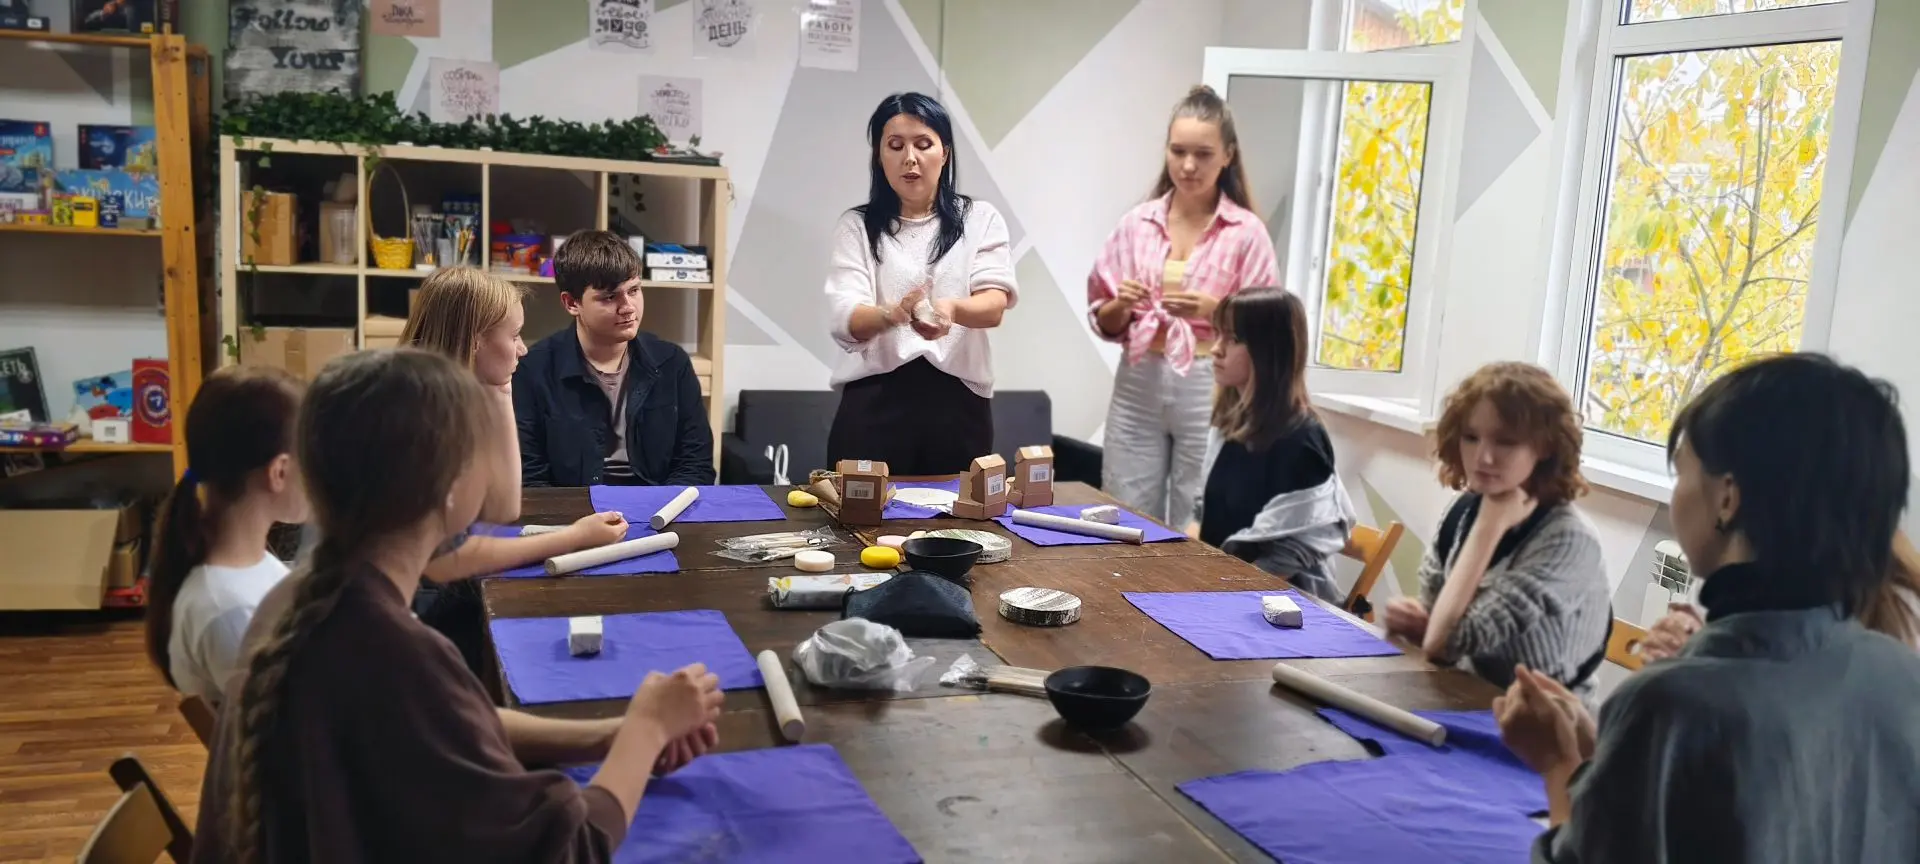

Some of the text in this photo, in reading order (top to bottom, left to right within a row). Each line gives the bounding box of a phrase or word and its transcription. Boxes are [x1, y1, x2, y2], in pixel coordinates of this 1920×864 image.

[235, 7, 330, 32] Follow
[708, 21, 748, 41] ДЕНЬ
[268, 46, 345, 70] Your
